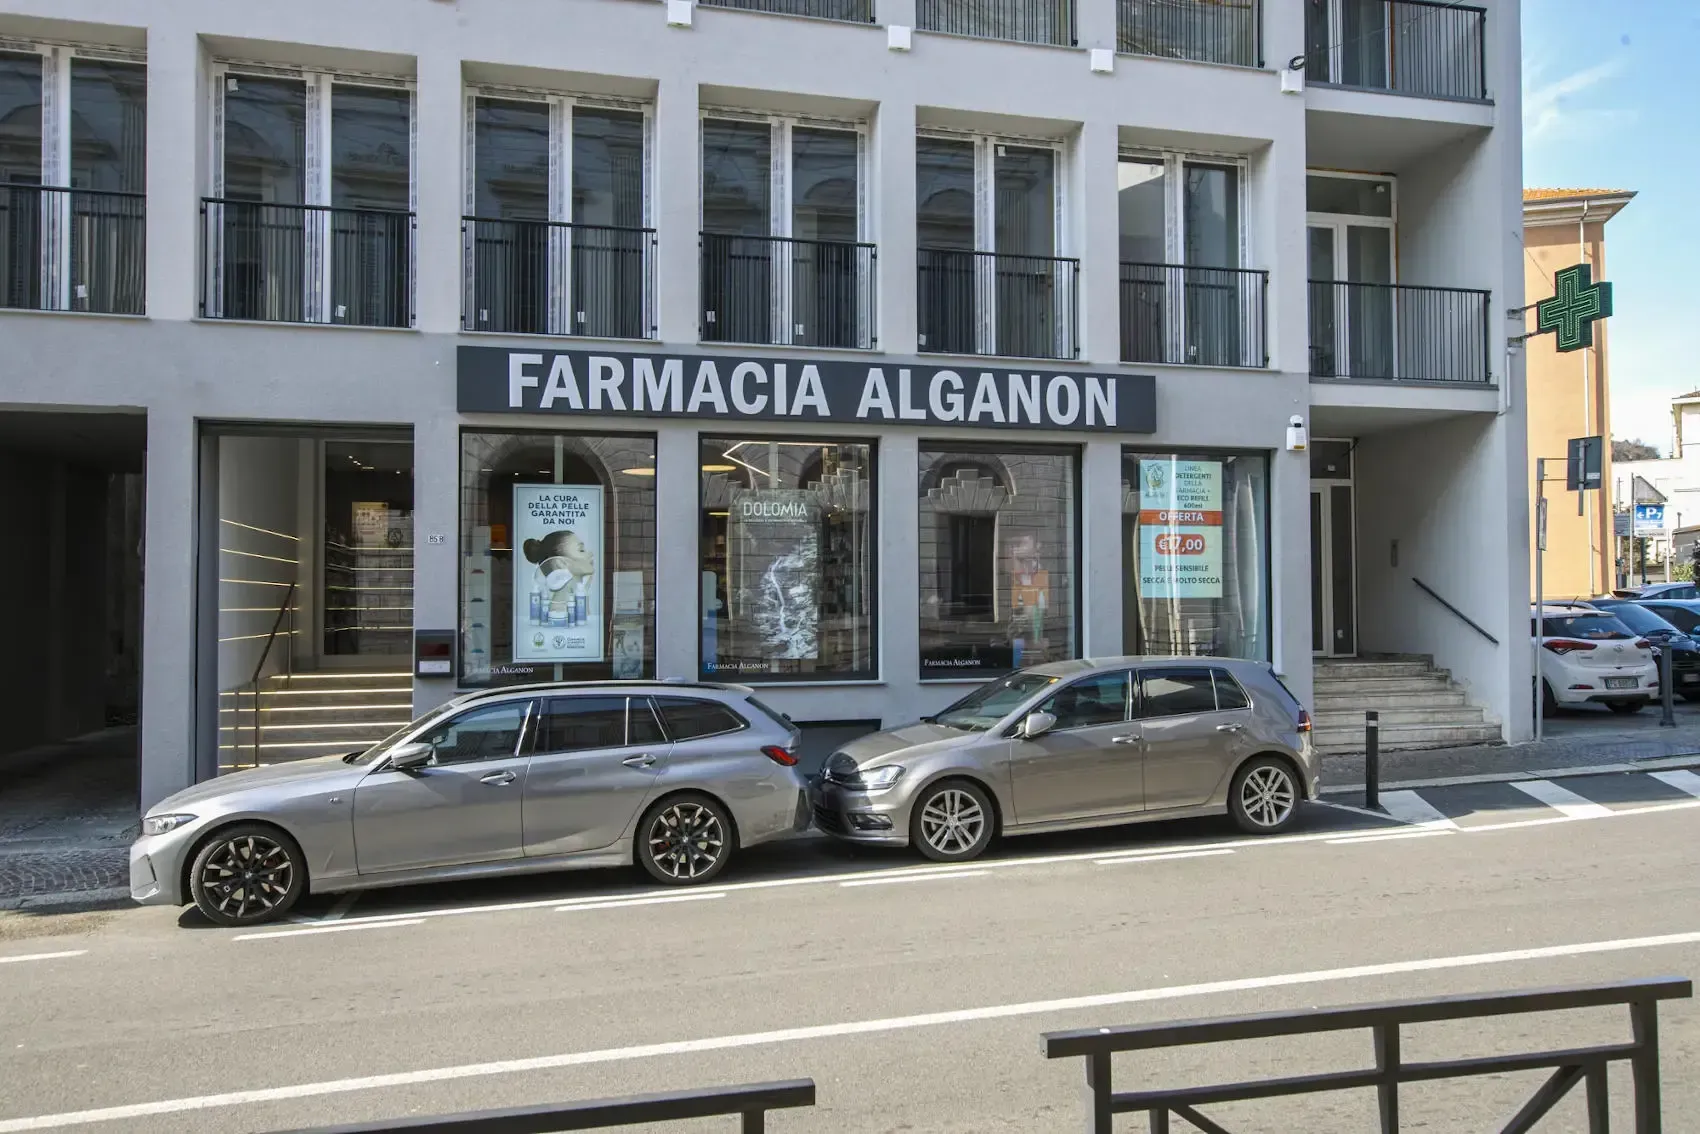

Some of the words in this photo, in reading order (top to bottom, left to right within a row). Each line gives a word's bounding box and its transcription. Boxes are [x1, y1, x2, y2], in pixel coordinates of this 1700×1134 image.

[508, 353, 831, 416] FARMACIA
[856, 367, 1117, 427] ALGANON
[743, 501, 808, 517] DOLOMIA
[1159, 511, 1204, 521] OFFERTA
[1154, 564, 1174, 572] PELL
[1175, 564, 1209, 572] SENSIBILE
[739, 661, 769, 669] ALGANON
[500, 666, 534, 674] ALGANON
